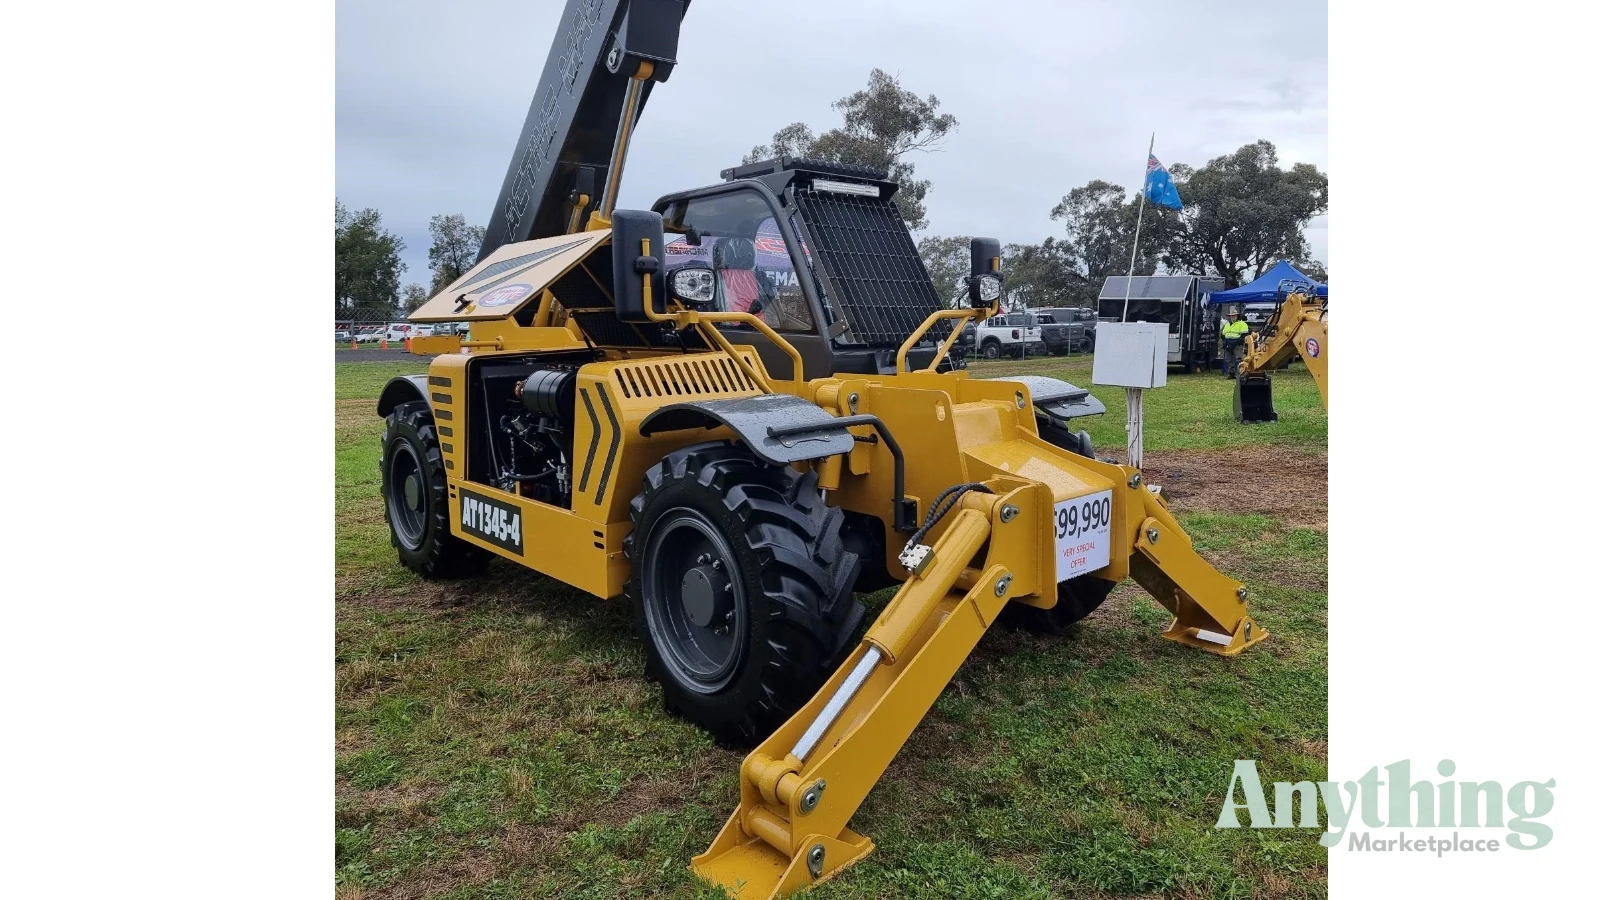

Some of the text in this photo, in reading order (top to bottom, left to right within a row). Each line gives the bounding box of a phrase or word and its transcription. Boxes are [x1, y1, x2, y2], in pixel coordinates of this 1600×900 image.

[462, 496, 520, 546] AT1345-4
[1063, 541, 1095, 557] VERY SPECIAL
